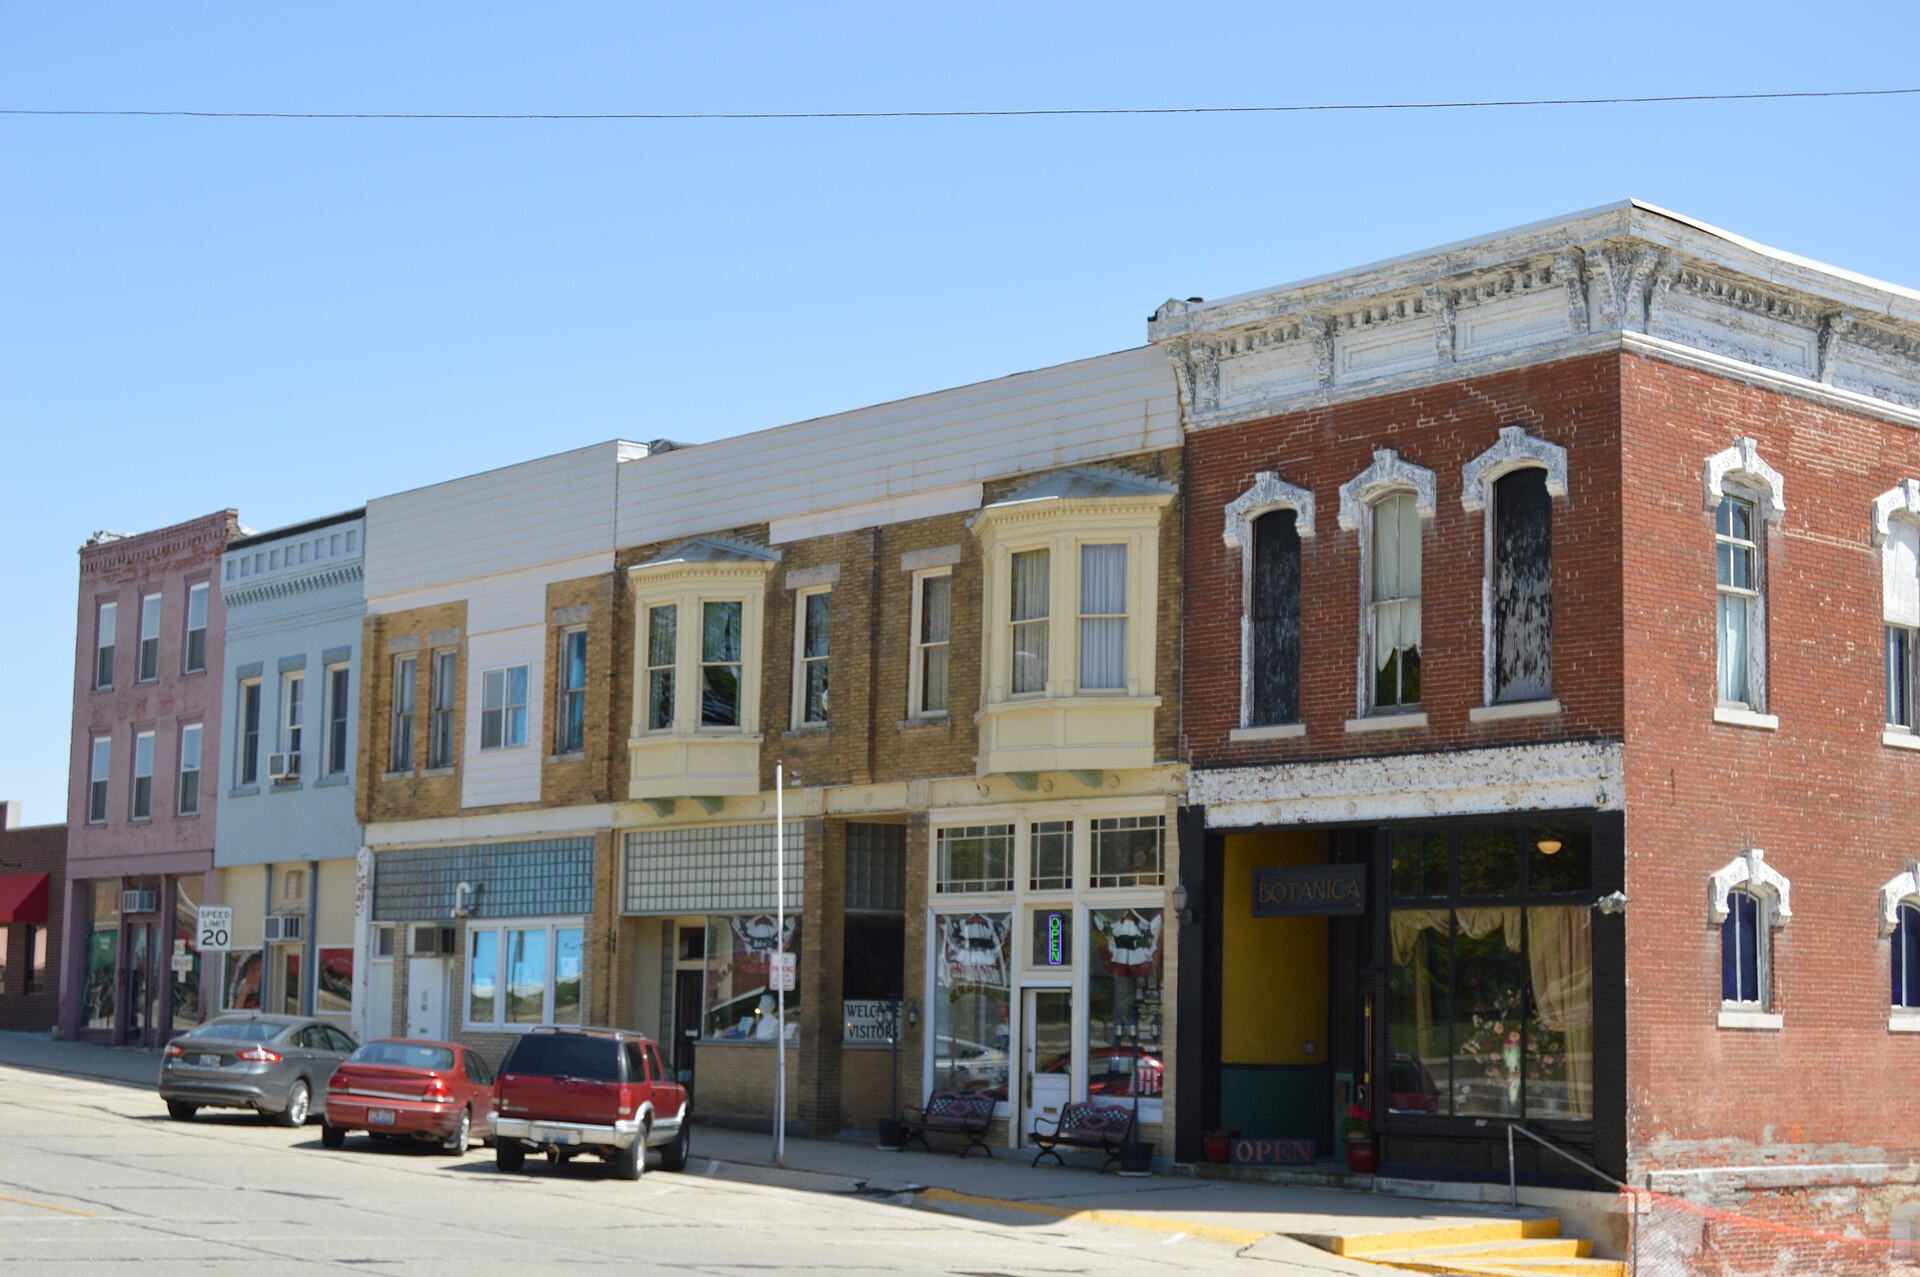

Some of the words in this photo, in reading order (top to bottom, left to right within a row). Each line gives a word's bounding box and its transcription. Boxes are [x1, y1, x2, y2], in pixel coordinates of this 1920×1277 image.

[1259, 880, 1360, 903] BOTANICA
[202, 929, 228, 946] 20
[1051, 917, 1060, 962] OPEN
[772, 966, 795, 974] PAKING
[847, 1004, 901, 1018] WELCE
[1236, 1140, 1313, 1163] OPEN
